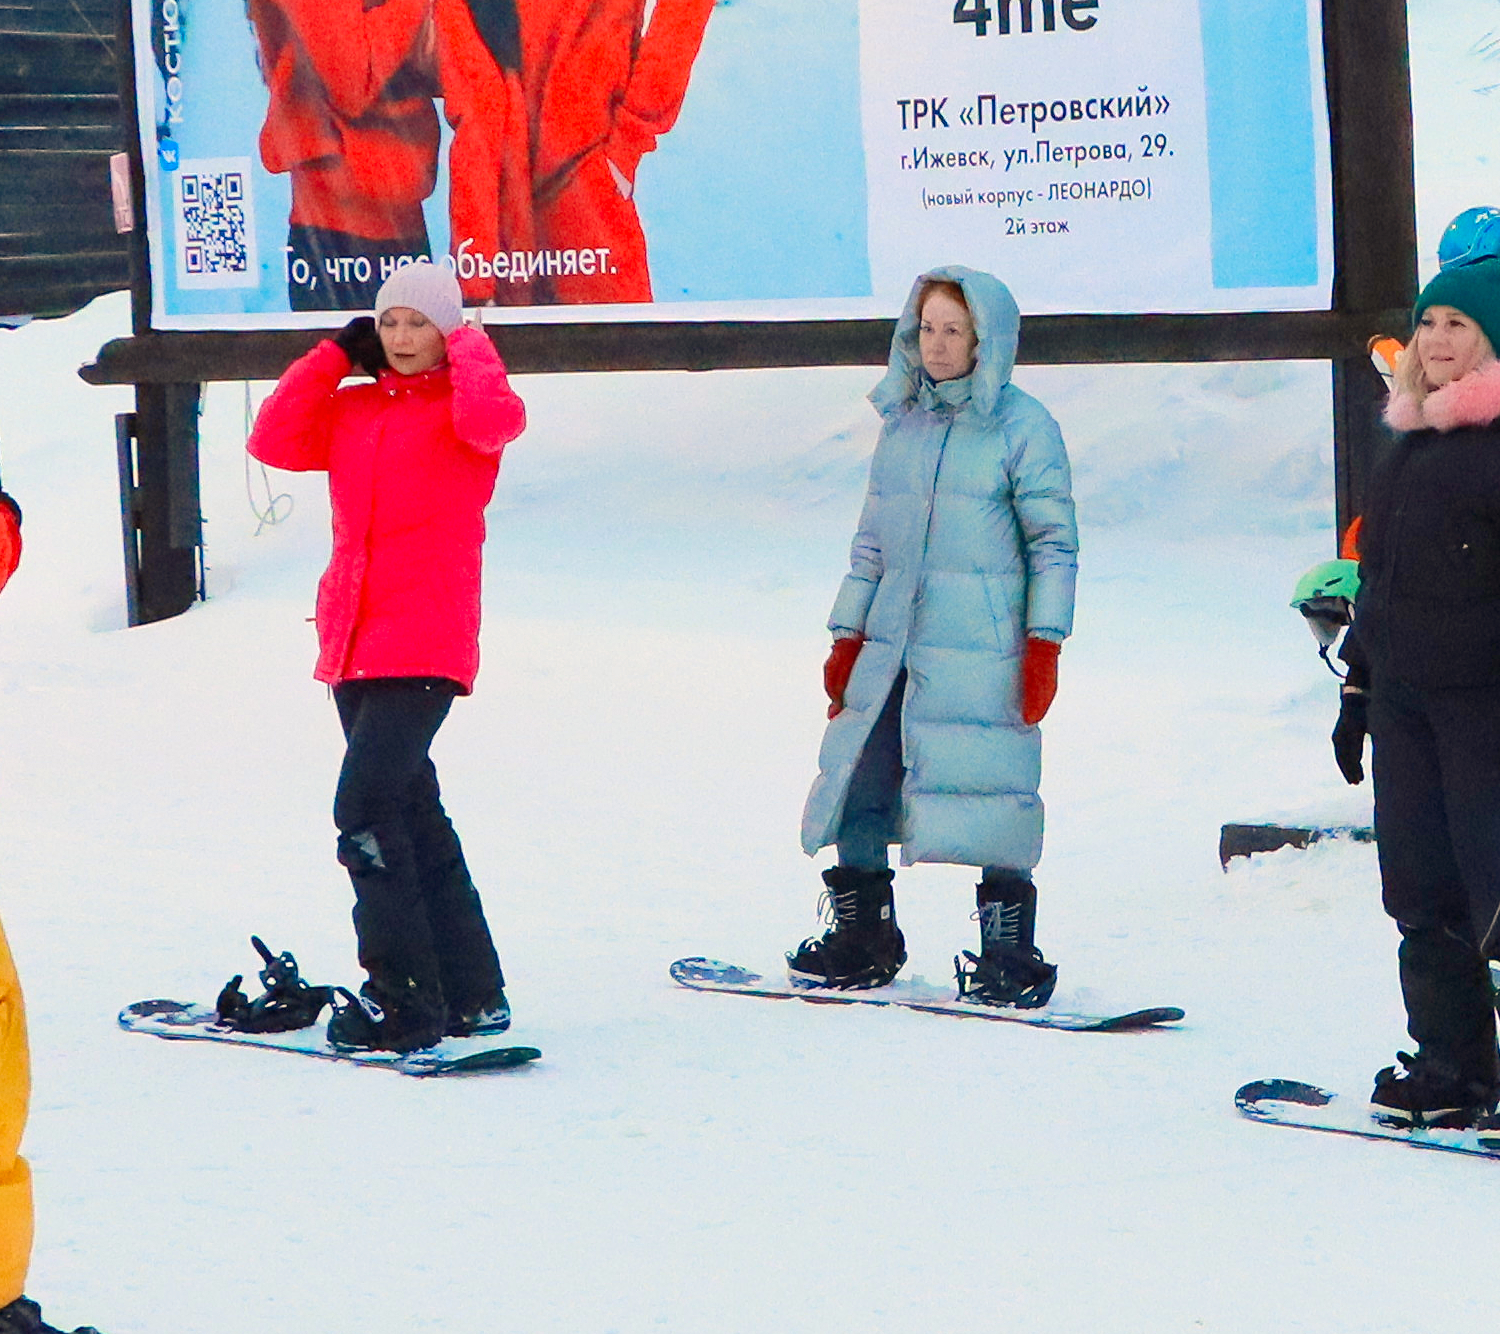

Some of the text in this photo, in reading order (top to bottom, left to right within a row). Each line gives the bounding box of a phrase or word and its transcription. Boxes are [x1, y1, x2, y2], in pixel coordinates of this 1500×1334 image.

[897, 85, 1170, 133] ТРК «Петровский»
[900, 133, 1174, 171] г.Ижевск, ул.Петрова, 29.
[922, 188, 973, 209] (новый
[978, 187, 1033, 209] корпус
[1048, 177, 1152, 201] ЛЕОНАРДО)
[1005, 218, 1070, 235] 2й этаж
[281, 246, 317, 290] То,
[325, 255, 371, 283] что
